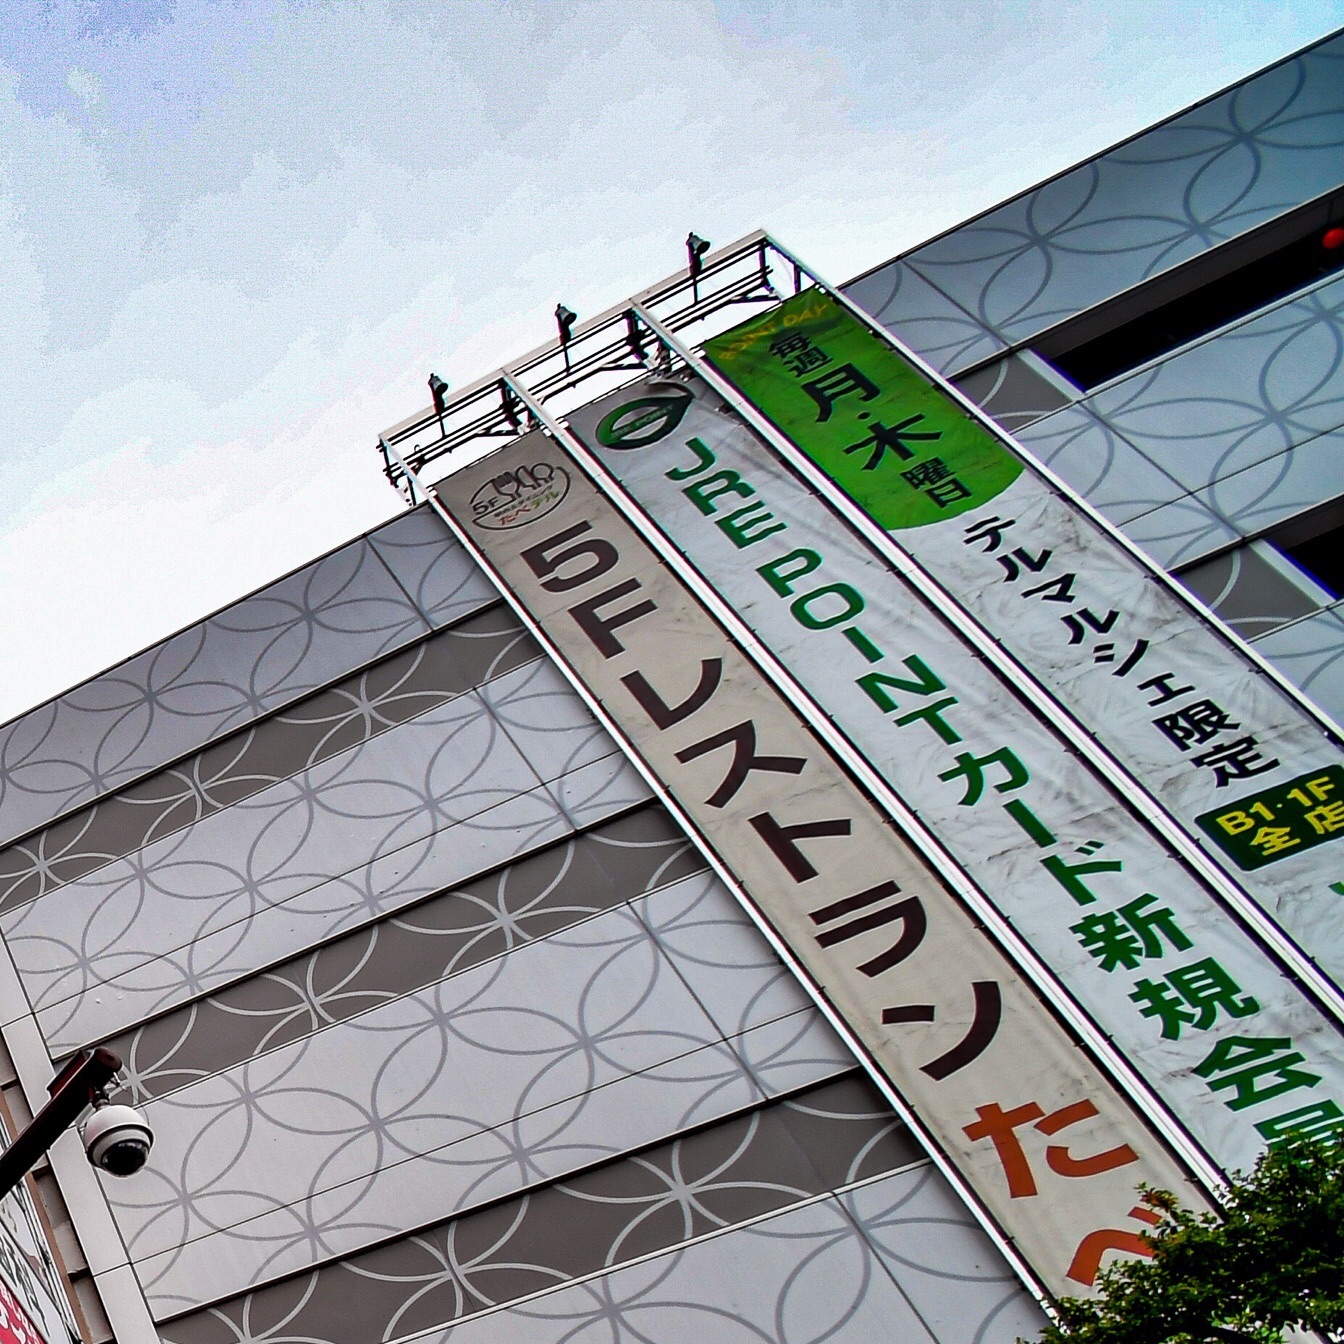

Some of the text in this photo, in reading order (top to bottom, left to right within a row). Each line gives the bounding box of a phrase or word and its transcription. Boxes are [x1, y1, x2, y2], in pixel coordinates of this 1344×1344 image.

[472, 495, 498, 517] 5F
[664, 437, 787, 550] JRE
[963, 516, 1280, 788] テルマルシェ限定
